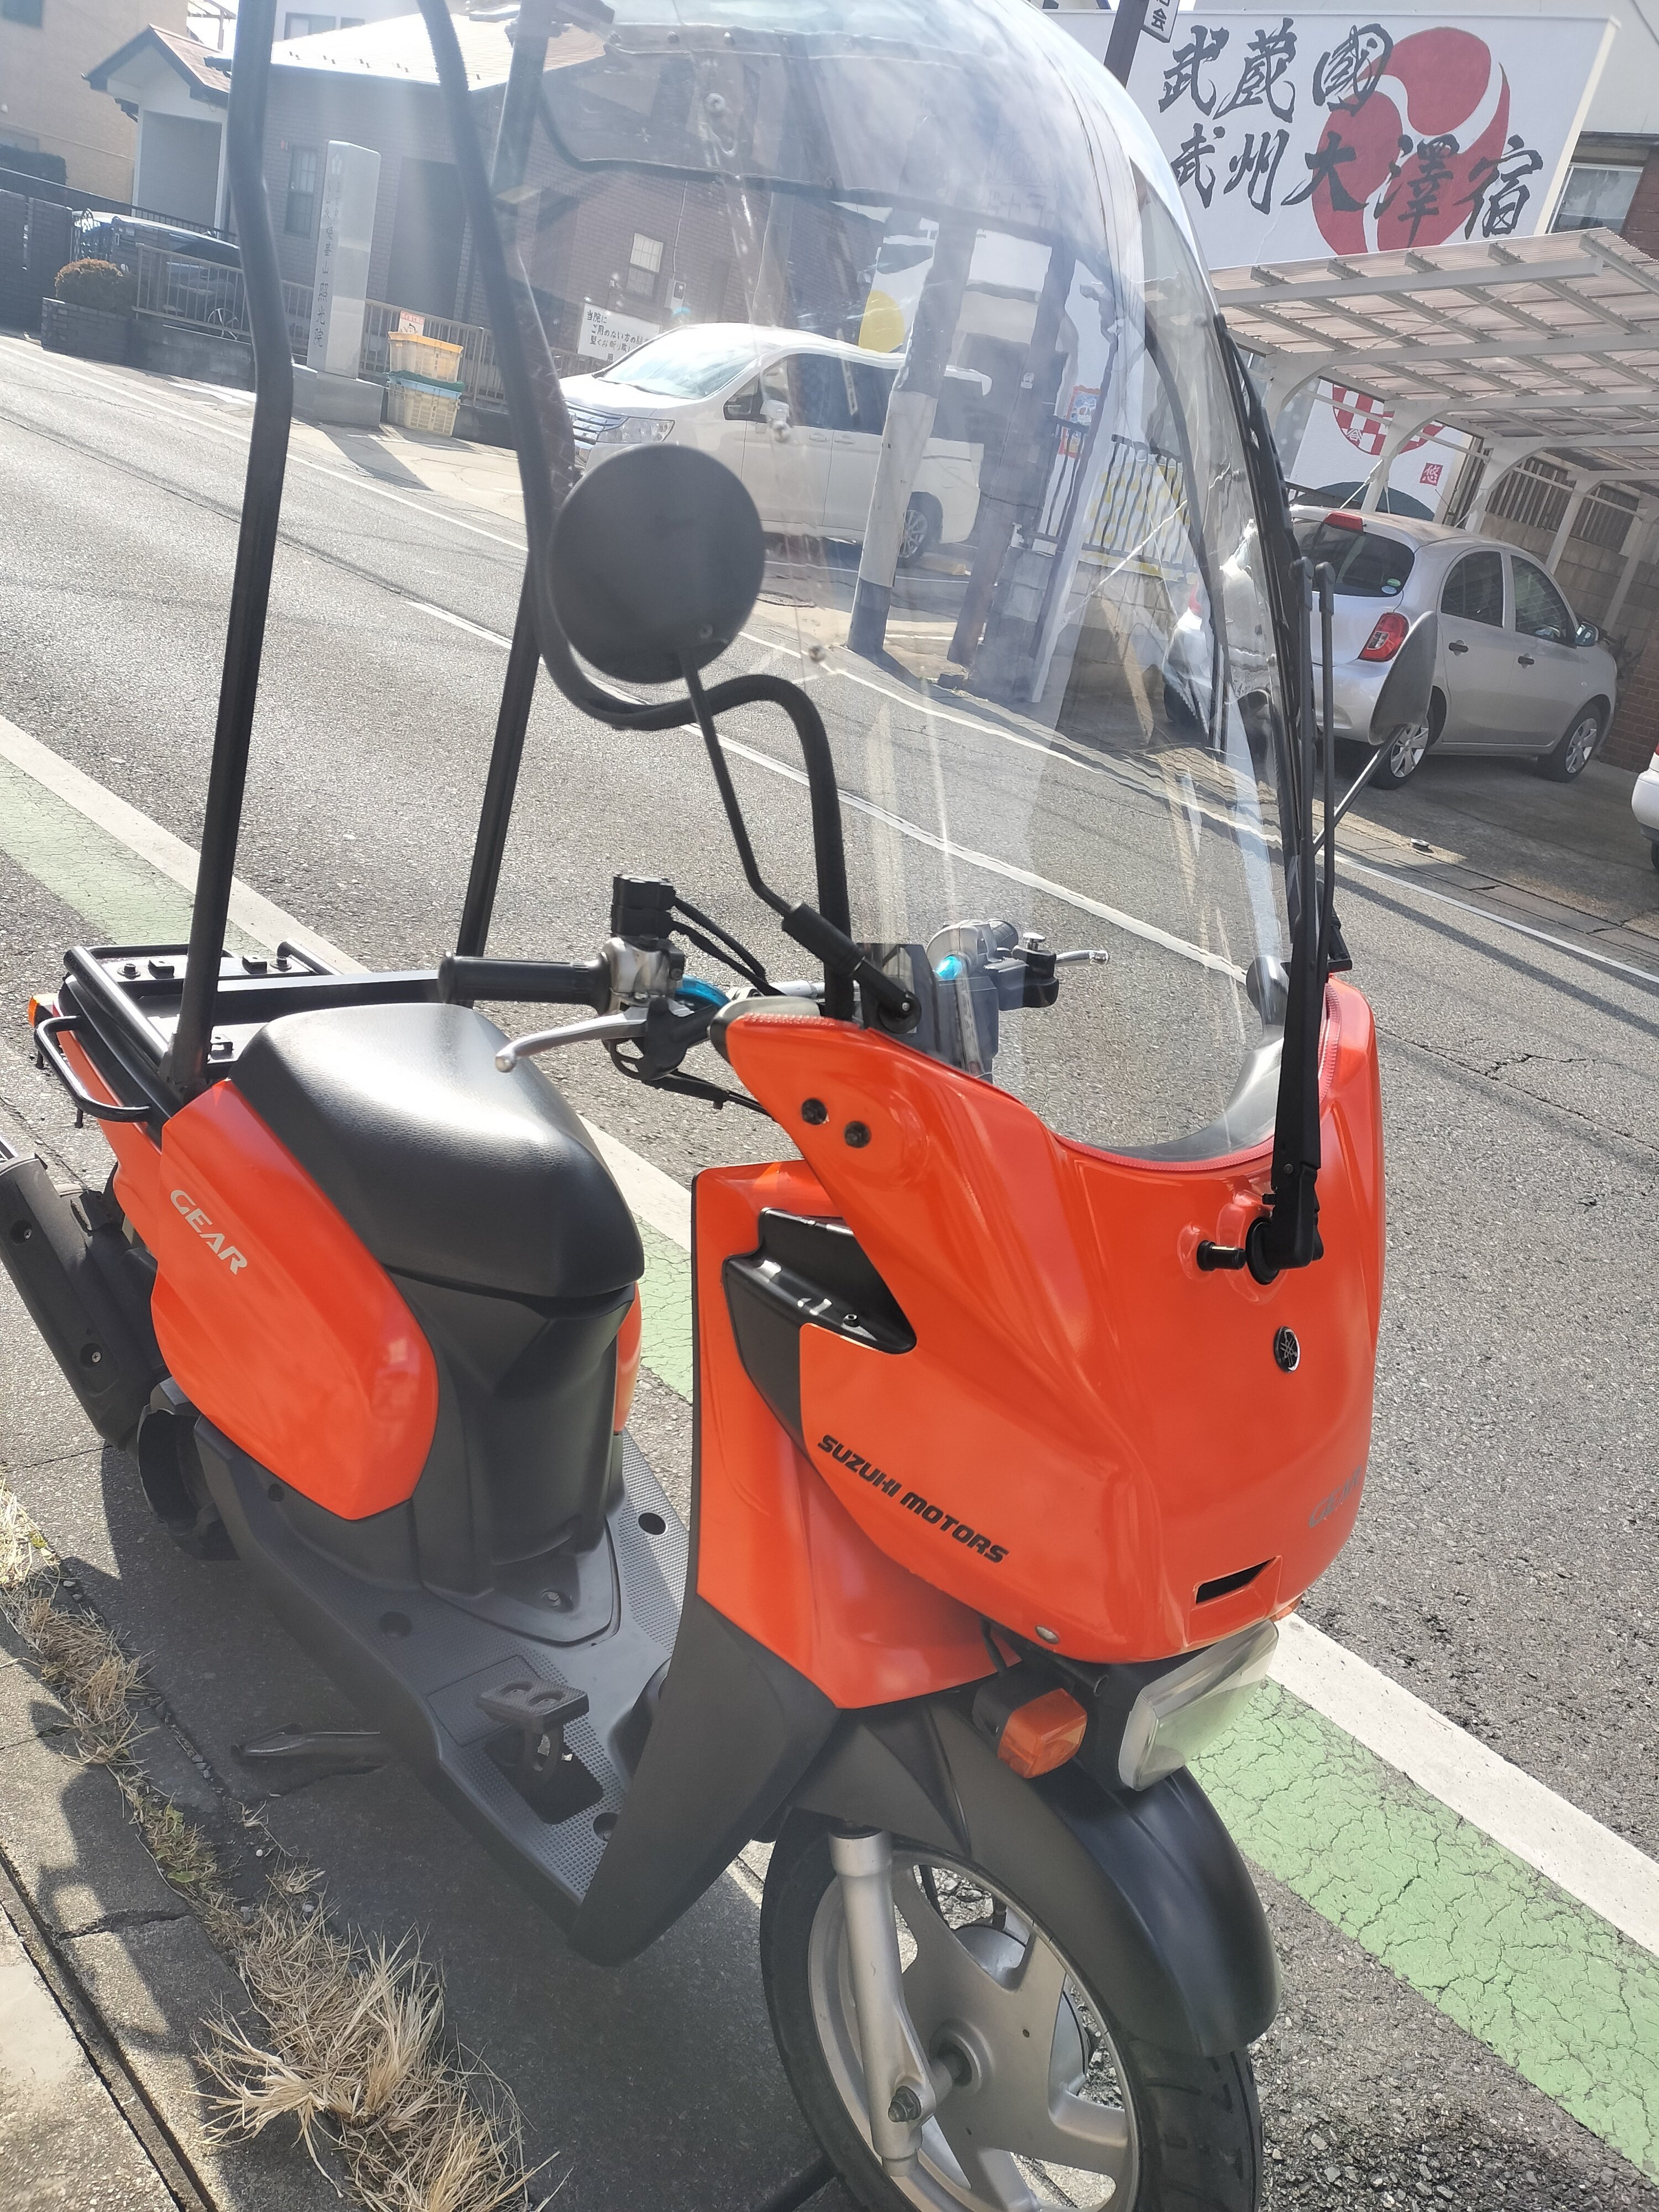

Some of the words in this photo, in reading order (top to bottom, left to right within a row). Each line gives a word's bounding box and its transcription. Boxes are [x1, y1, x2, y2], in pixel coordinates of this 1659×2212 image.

[587, 309, 607, 324] 当院に
[1423, 465, 1440, 483] 悠
[170, 1190, 247, 1274] GEAR
[817, 1435, 902, 1497] SUZUKI
[900, 1492, 1008, 1563] MOTORS
[1308, 1465, 1361, 1528] GEAR
